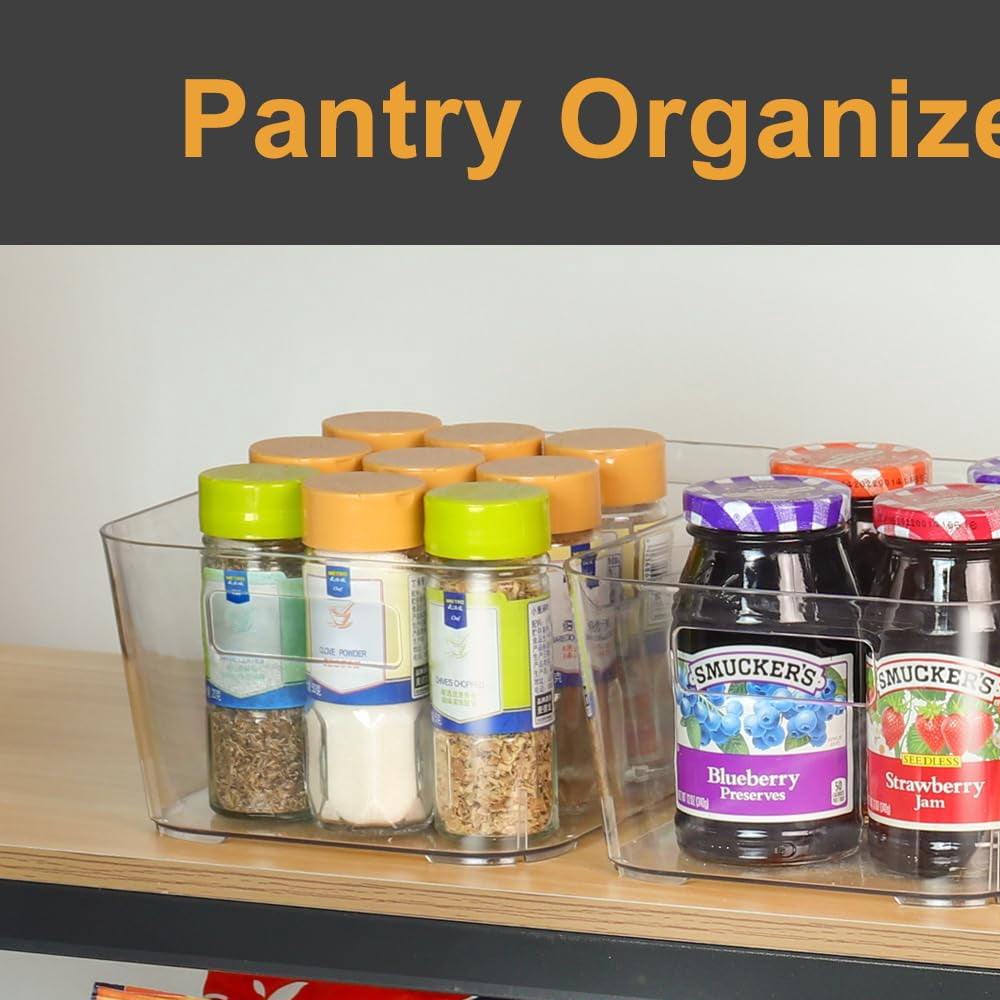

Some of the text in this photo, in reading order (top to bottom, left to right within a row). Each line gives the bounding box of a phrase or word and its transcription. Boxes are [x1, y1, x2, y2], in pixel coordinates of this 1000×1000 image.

[693, 657, 818, 687] SMUCKER'S
[878, 664, 996, 696] SMUCKER'S
[903, 753, 961, 767] SEEDLESS
[706, 765, 801, 791] Blueberry
[885, 771, 986, 798] Strawberry
[719, 786, 787, 802] Preserves
[913, 794, 946, 811] Jam
